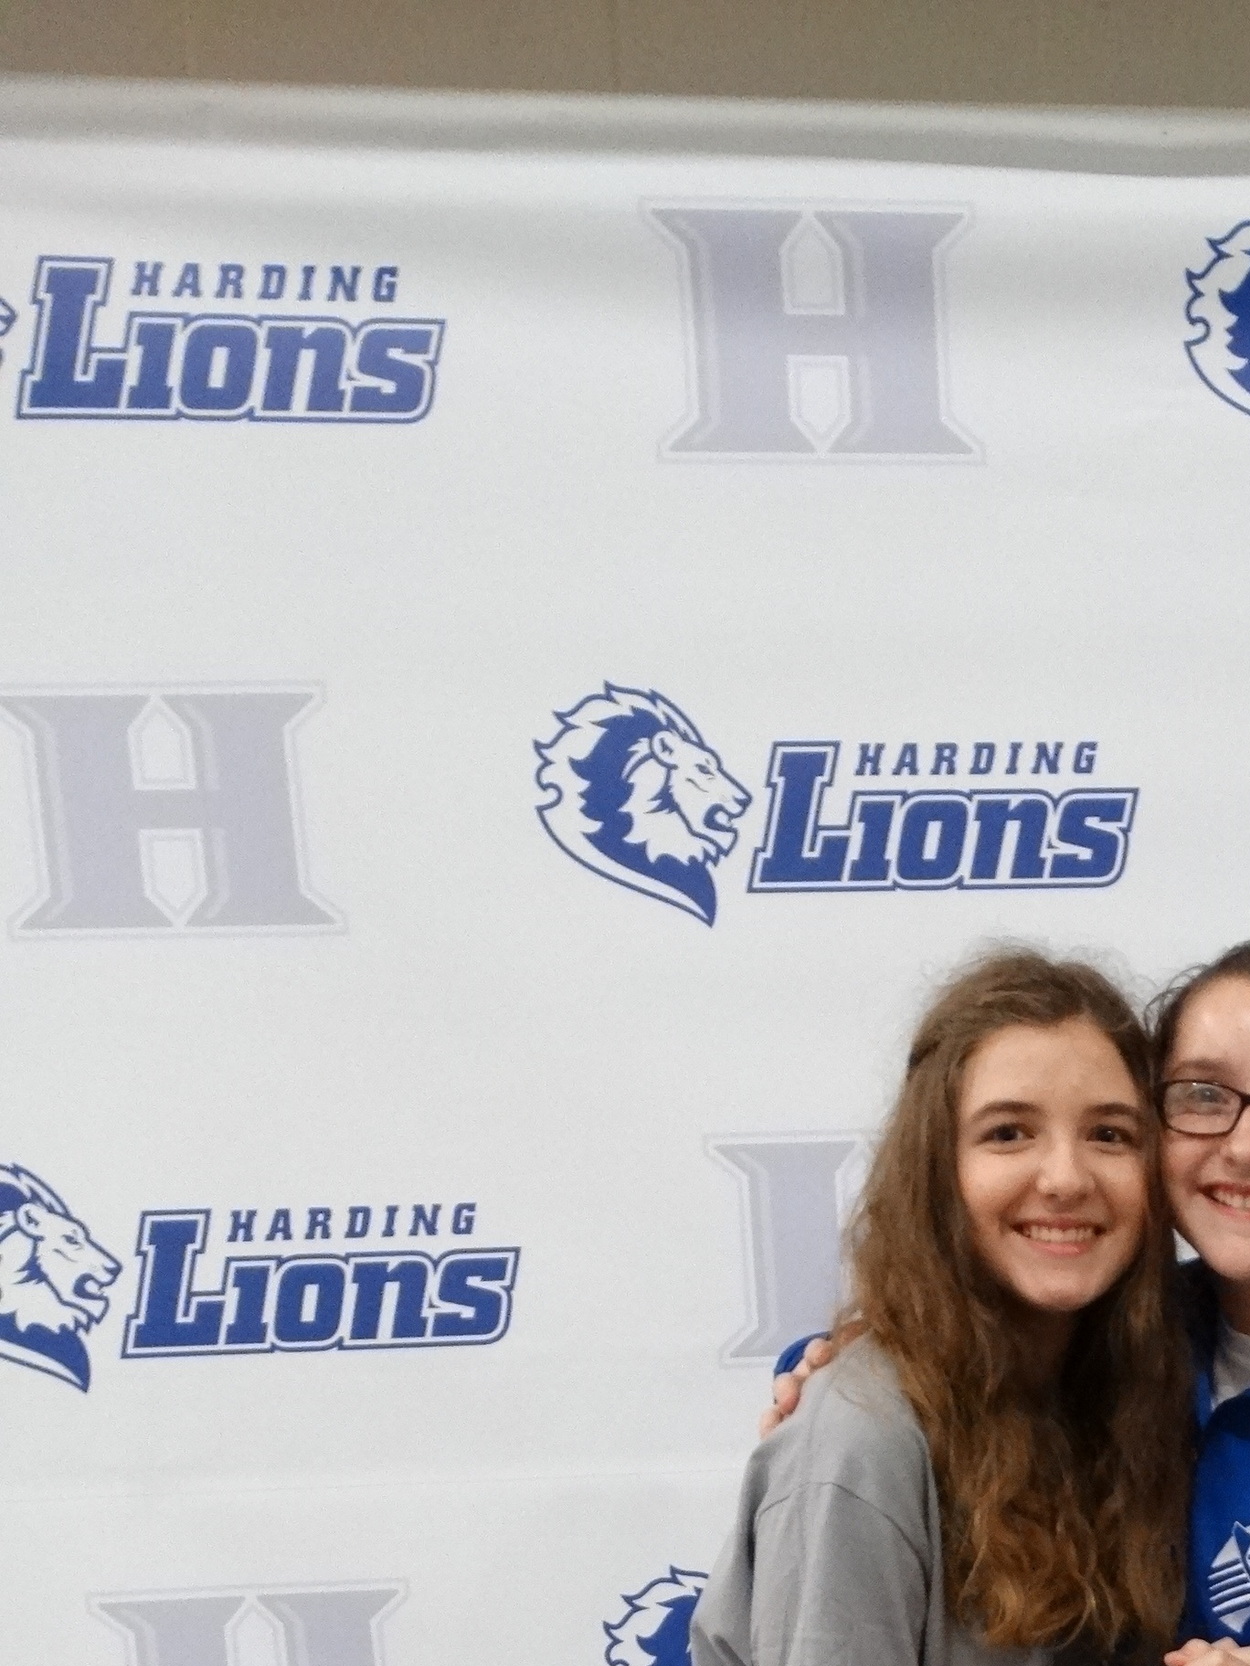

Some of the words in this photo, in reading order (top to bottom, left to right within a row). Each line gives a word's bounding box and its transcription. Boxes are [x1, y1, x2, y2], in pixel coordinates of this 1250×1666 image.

[130, 261, 400, 303] HARDING
[638, 201, 987, 464] H
[855, 741, 1098, 777] HARDING
[0, 680, 346, 940] H
[227, 1203, 477, 1243] HARDING
